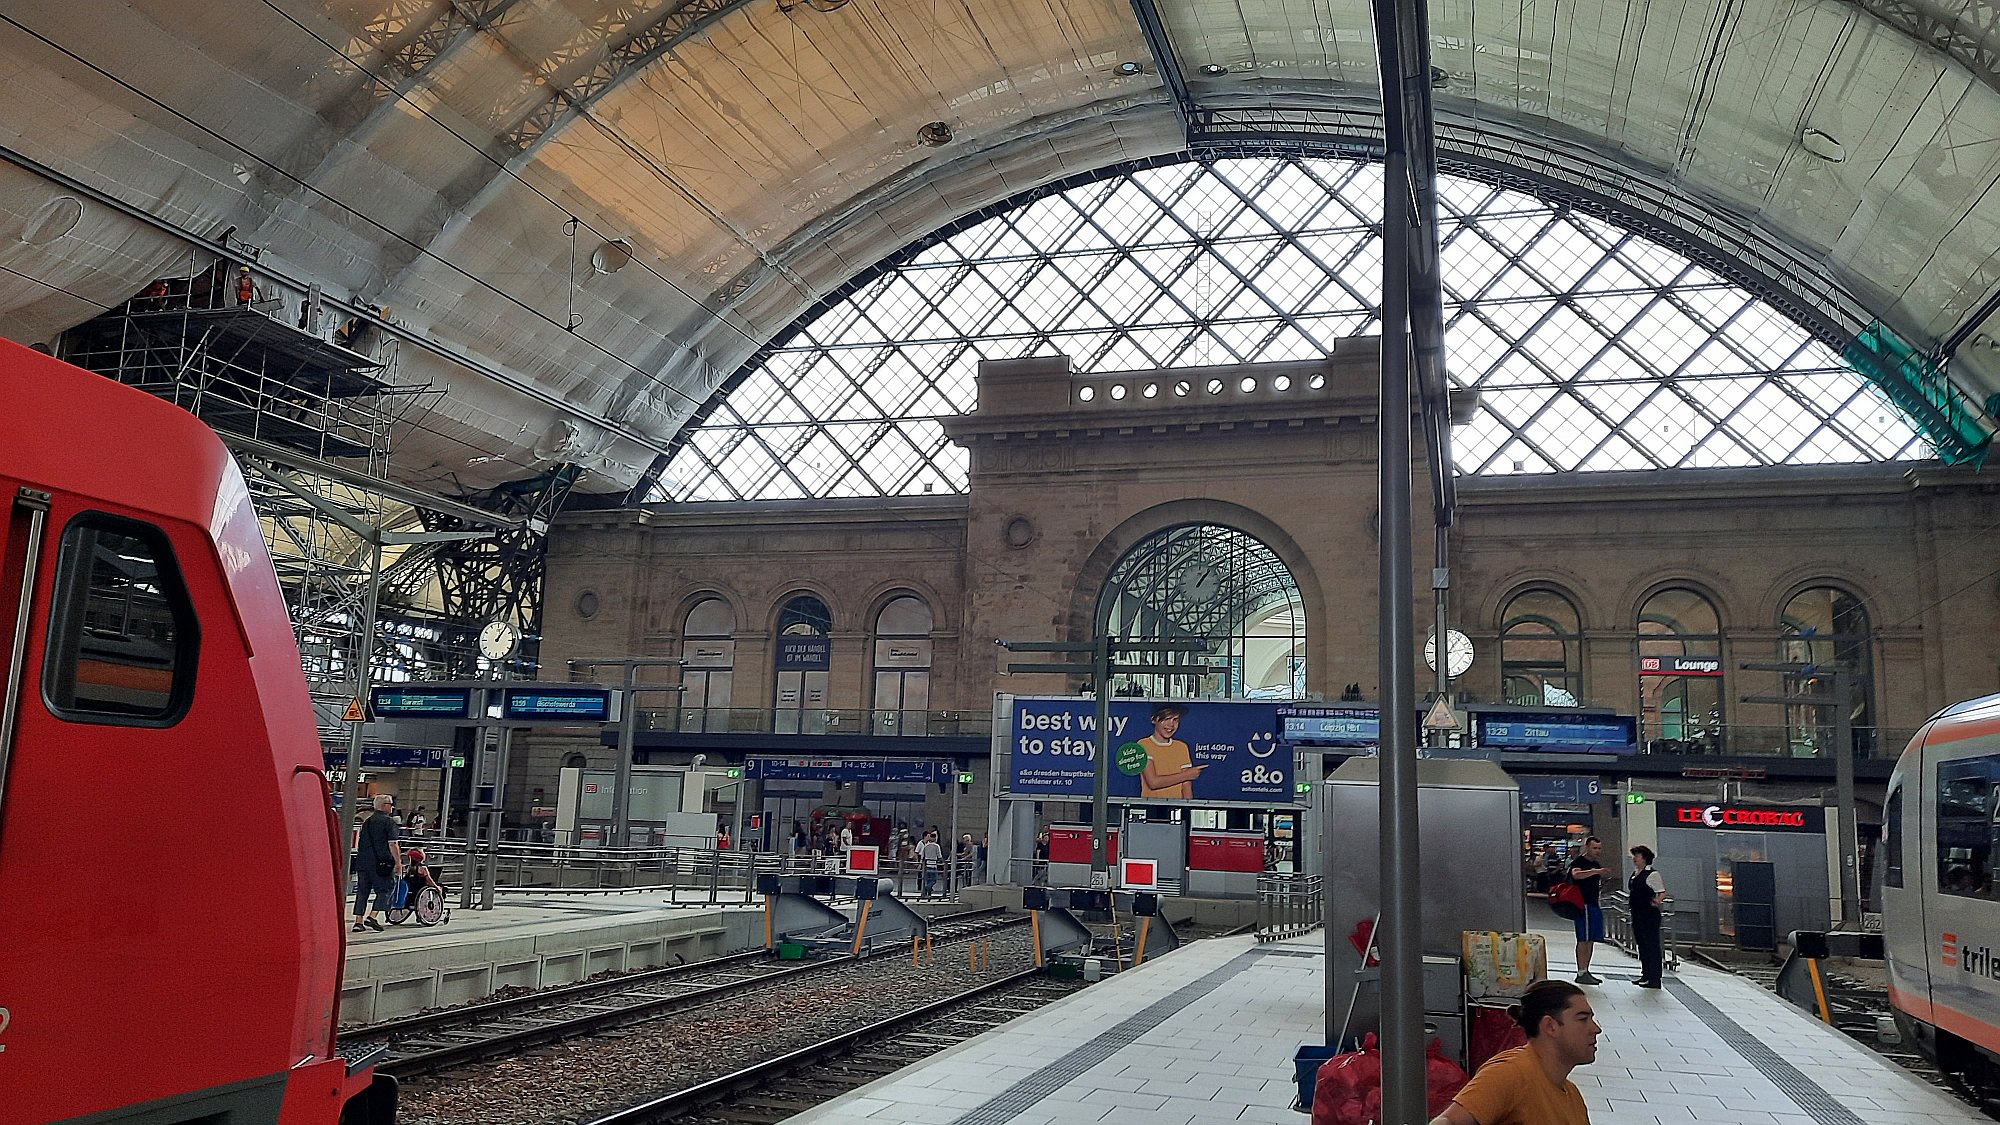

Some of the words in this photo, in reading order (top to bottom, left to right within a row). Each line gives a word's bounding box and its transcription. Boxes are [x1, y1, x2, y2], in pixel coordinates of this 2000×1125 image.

[1675, 659, 1719, 672] Lounge
[1021, 708, 1072, 731] best
[1320, 723, 1345, 732] Leipzig
[1525, 728, 1549, 737] Zittau
[1019, 735, 1044, 755] to
[1050, 737, 1096, 761] stay
[1122, 748, 1137, 756] kids
[1195, 743, 1210, 752] just
[430, 750, 441, 760] 10
[1211, 753, 1227, 761] way
[1118, 756, 1136, 766] sleep
[748, 760, 756, 771] 9
[941, 763, 948, 774] 8
[1127, 762, 1141, 771] free
[1241, 764, 1284, 785] a&o
[1588, 780, 1599, 794] 6
[1677, 807, 1704, 823] LE
[1722, 810, 1805, 828] CROBAG
